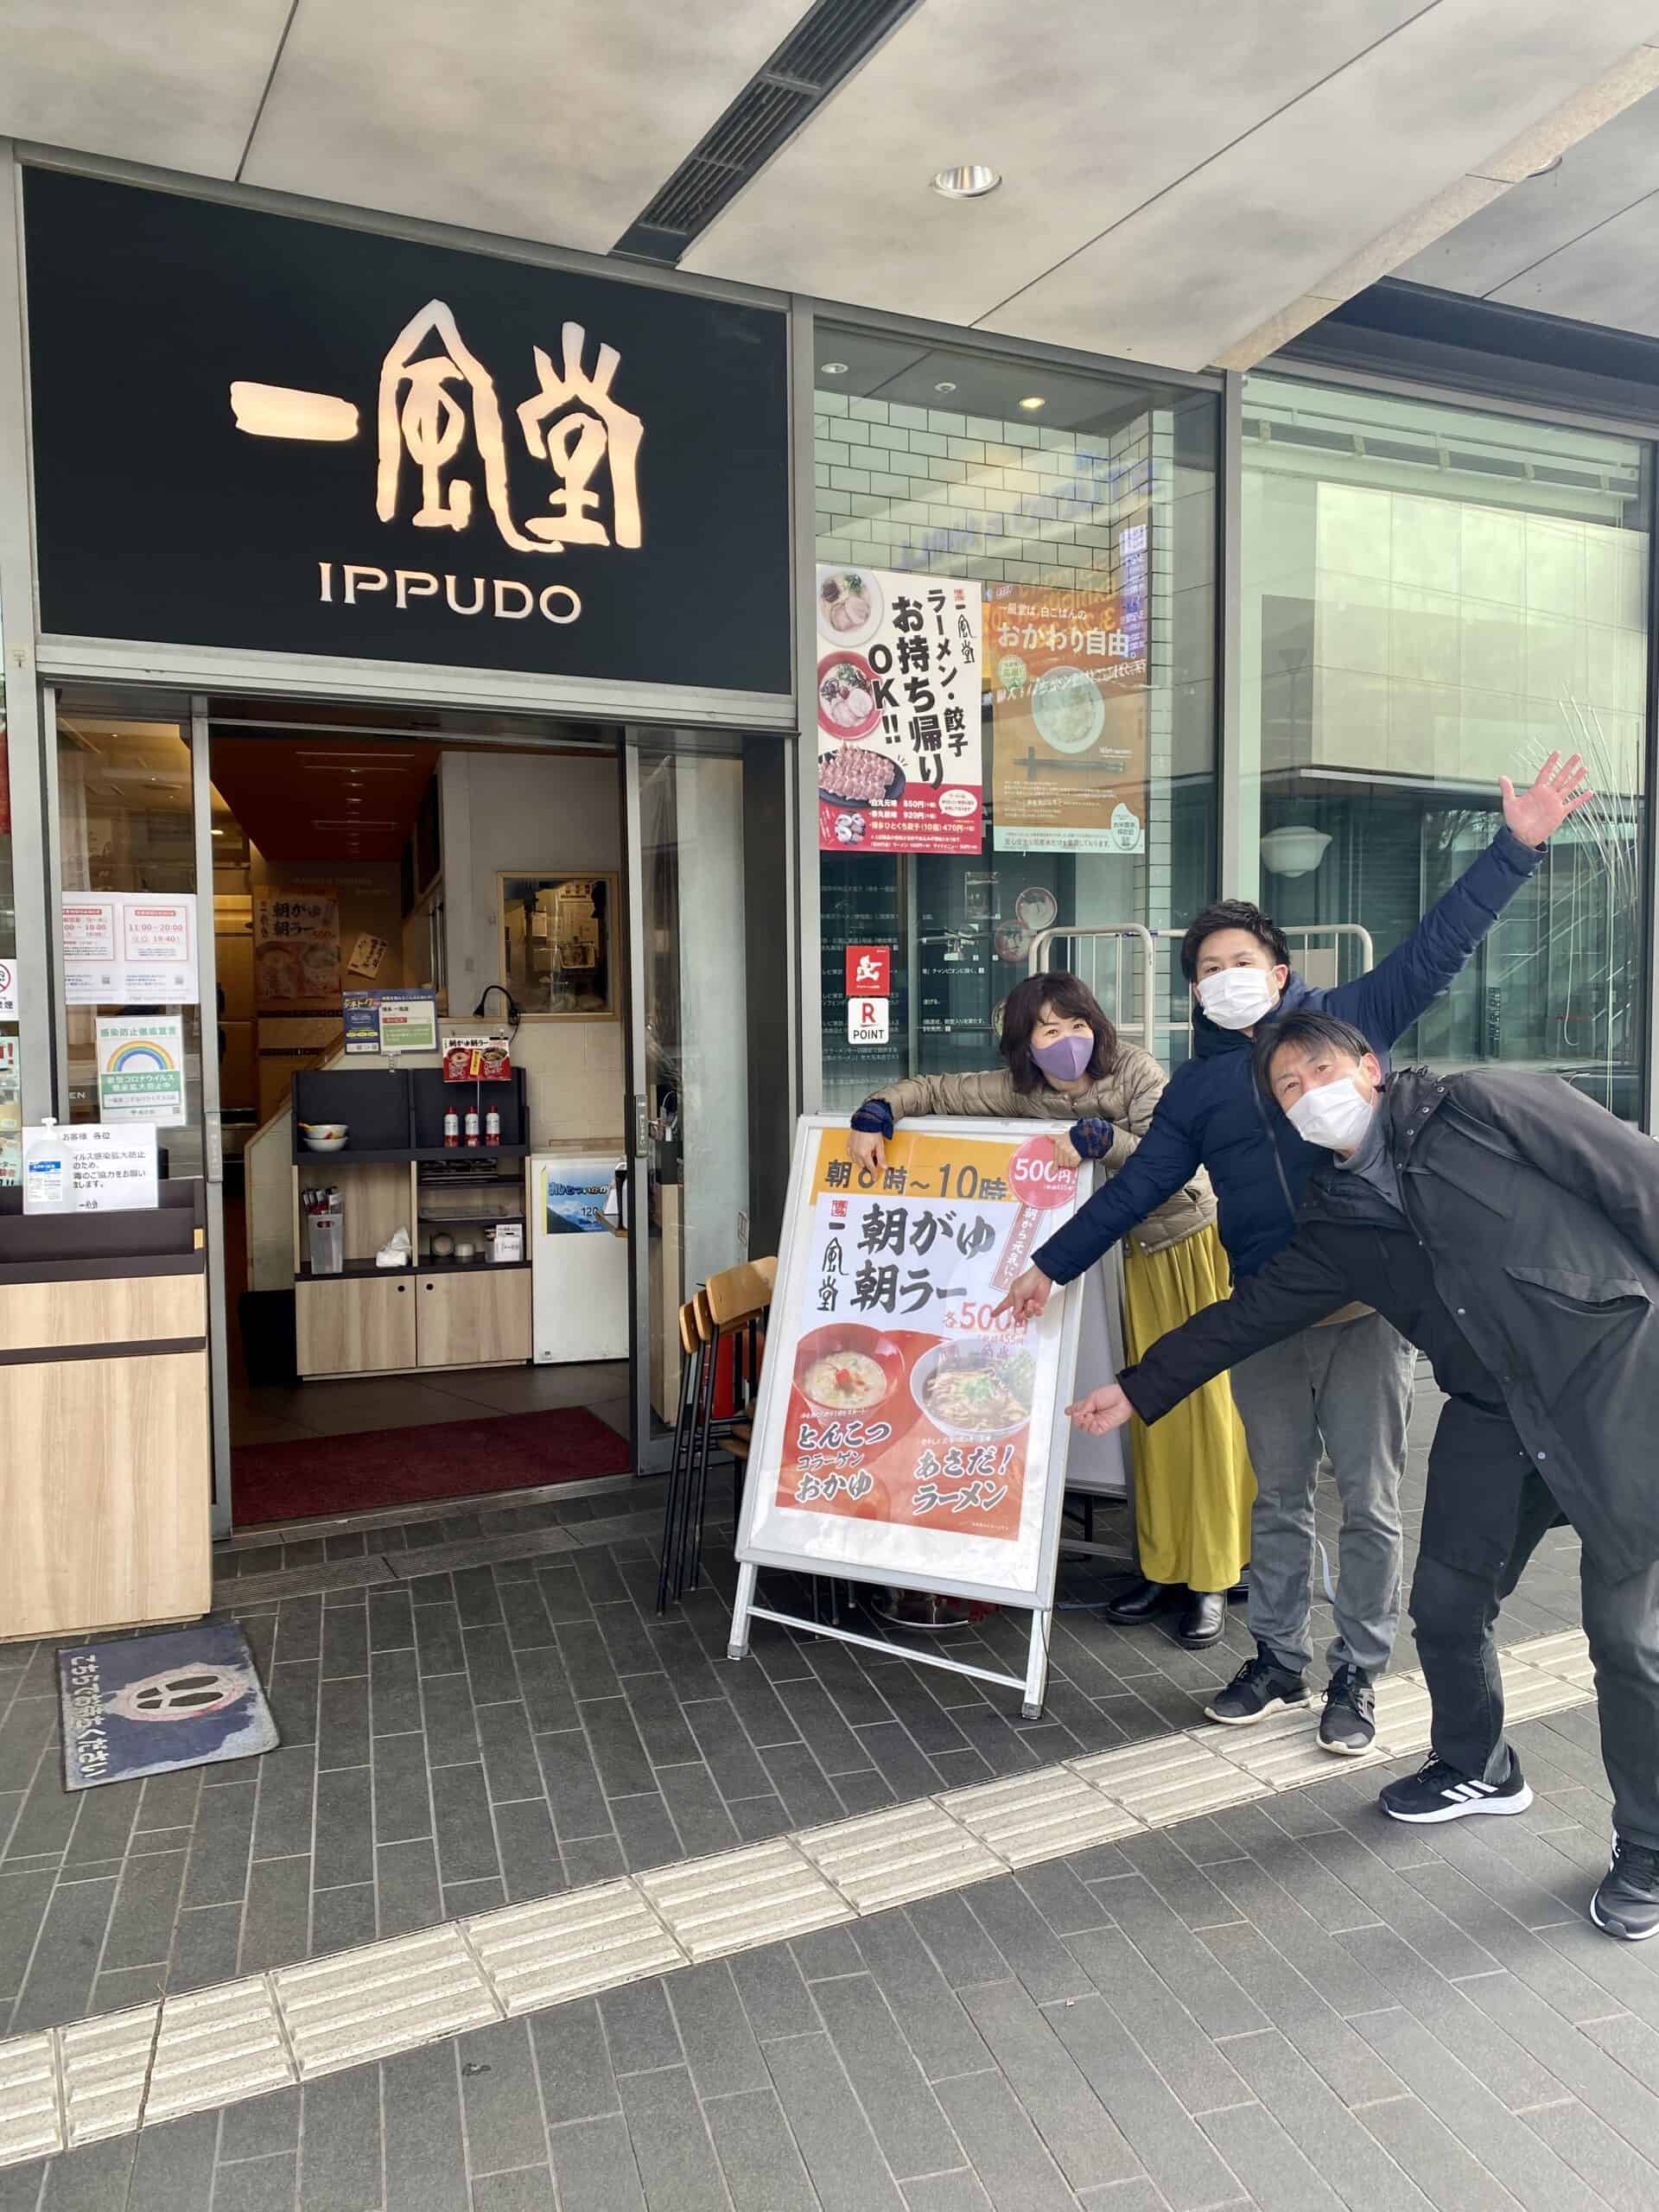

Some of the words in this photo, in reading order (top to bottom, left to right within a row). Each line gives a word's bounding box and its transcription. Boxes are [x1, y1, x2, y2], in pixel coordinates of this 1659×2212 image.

[230, 299, 644, 552] 一風堂
[319, 562, 582, 624] IPPUDO
[956, 604, 976, 664] 一風堂
[998, 622, 1129, 658] おかわり自由
[892, 596, 944, 789] お持ち帰り
[927, 589, 968, 757] ラーメン・餃子
[853, 1029, 884, 1039] POINT
[861, 1002, 876, 1023] R
[856, 1203, 995, 1260] 朝がゆ
[817, 1222, 850, 1313] 一風堂
[849, 1260, 968, 1314] 朝ラー
[797, 1451, 864, 1471] コラーゲン
[798, 1421, 891, 1450] とんこつ
[795, 1469, 874, 1503] おかゆ
[912, 1480, 1008, 1516] ラーメン
[71, 1654, 110, 1778] こちらでお待ちください
